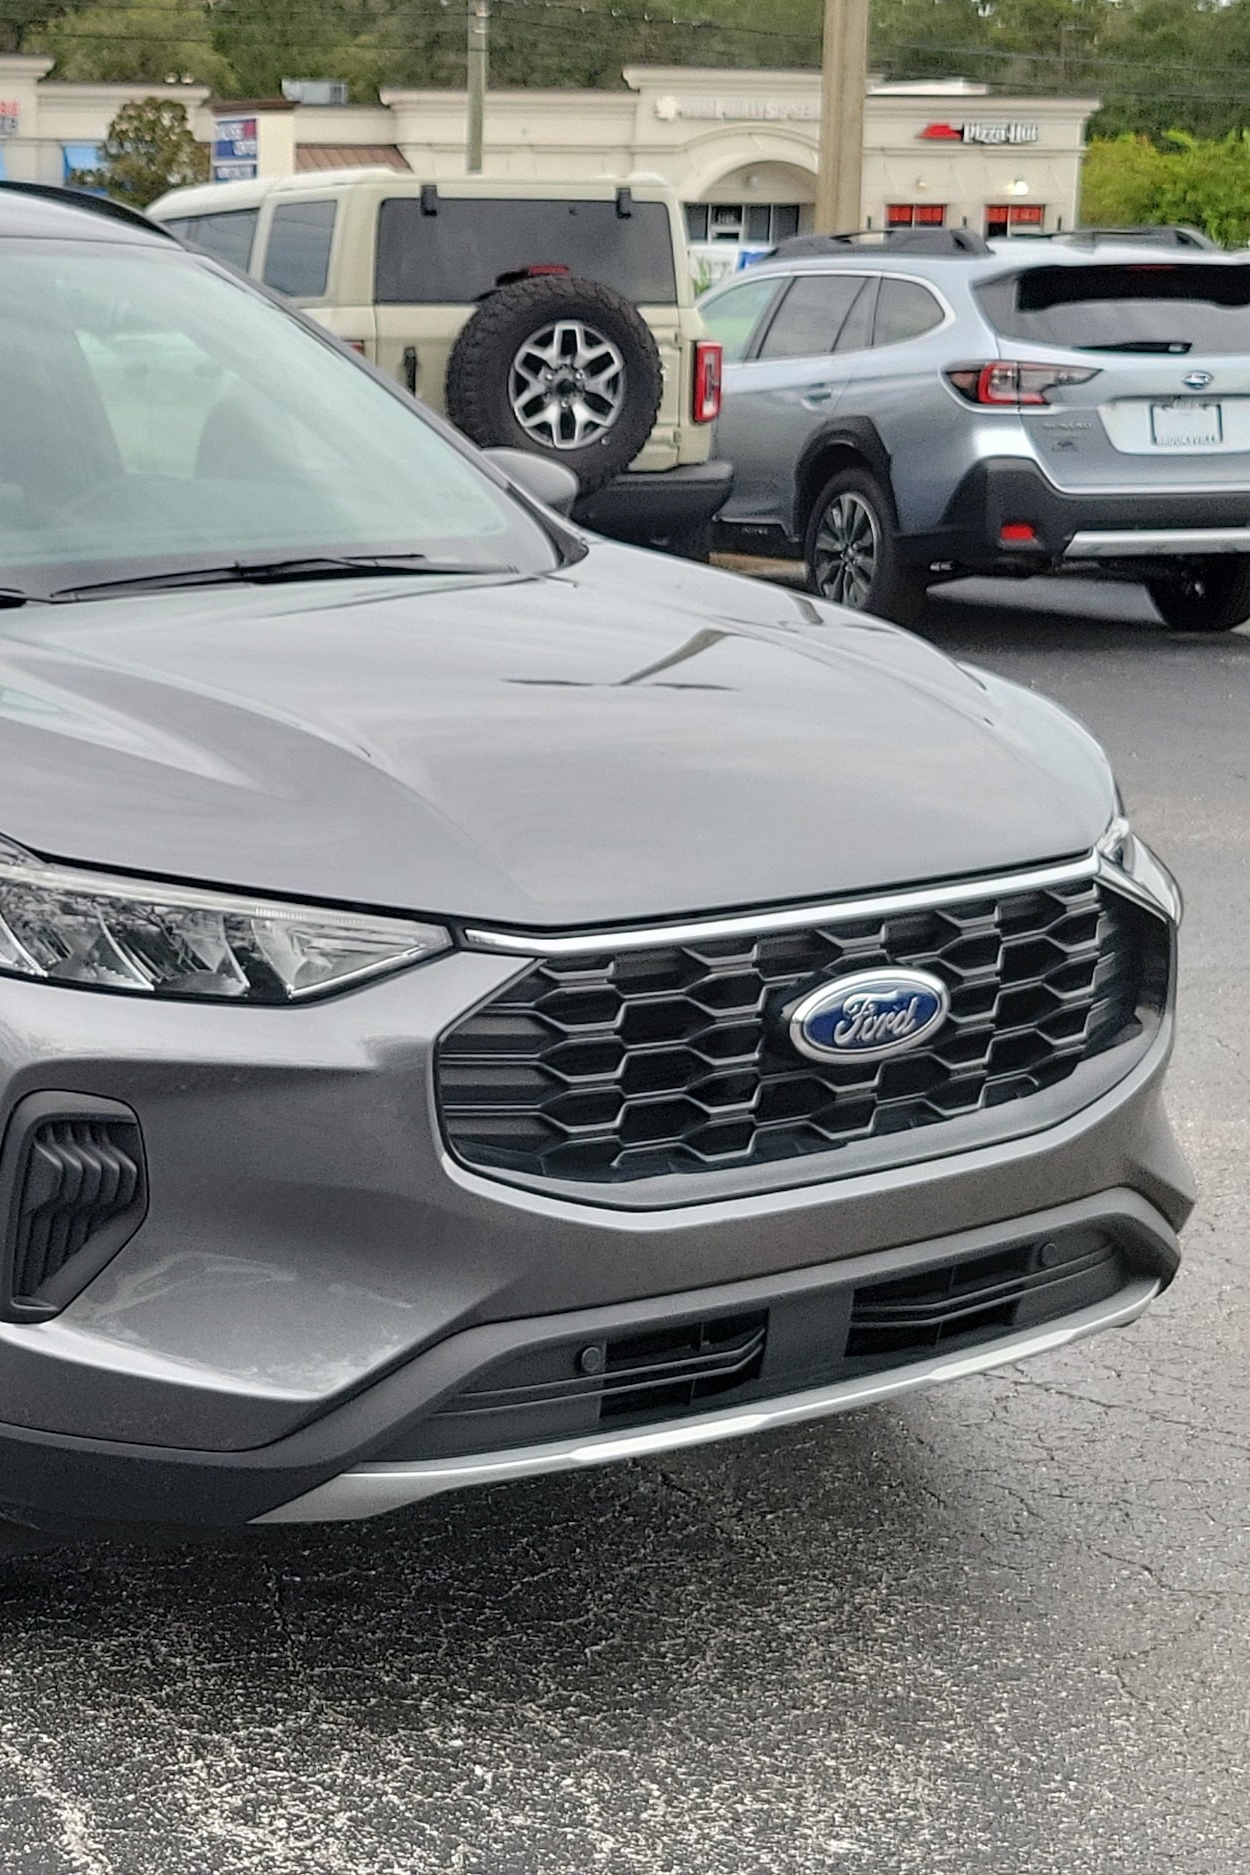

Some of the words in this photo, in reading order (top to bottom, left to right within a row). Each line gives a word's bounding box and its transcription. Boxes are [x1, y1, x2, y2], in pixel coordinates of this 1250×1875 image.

[963, 122, 1006, 144] Pizza
[1007, 122, 1038, 143] Hut
[833, 989, 920, 1046] Ford
